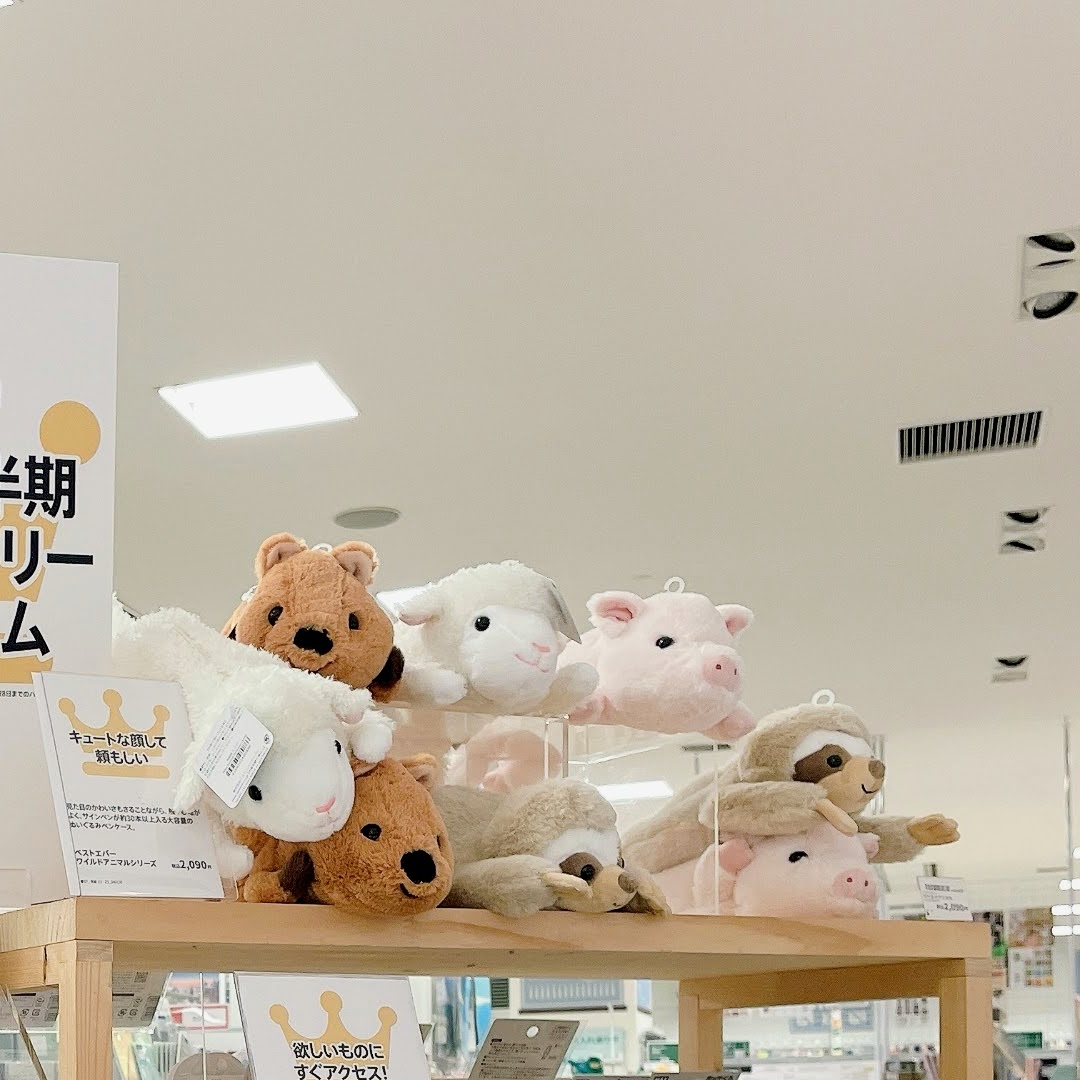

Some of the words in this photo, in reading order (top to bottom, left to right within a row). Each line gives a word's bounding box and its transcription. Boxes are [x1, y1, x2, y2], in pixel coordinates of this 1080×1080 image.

[69, 731, 167, 749] キュートな顔して
[95, 750, 149, 765] 頼もしい
[76, 858, 157, 868] ワイルドアニマルシリーズ
[172, 859, 212, 871] 税込2,090円
[293, 1043, 384, 1060] 欲しいものに
[294, 1064, 388, 1080] すぐアクセス!
